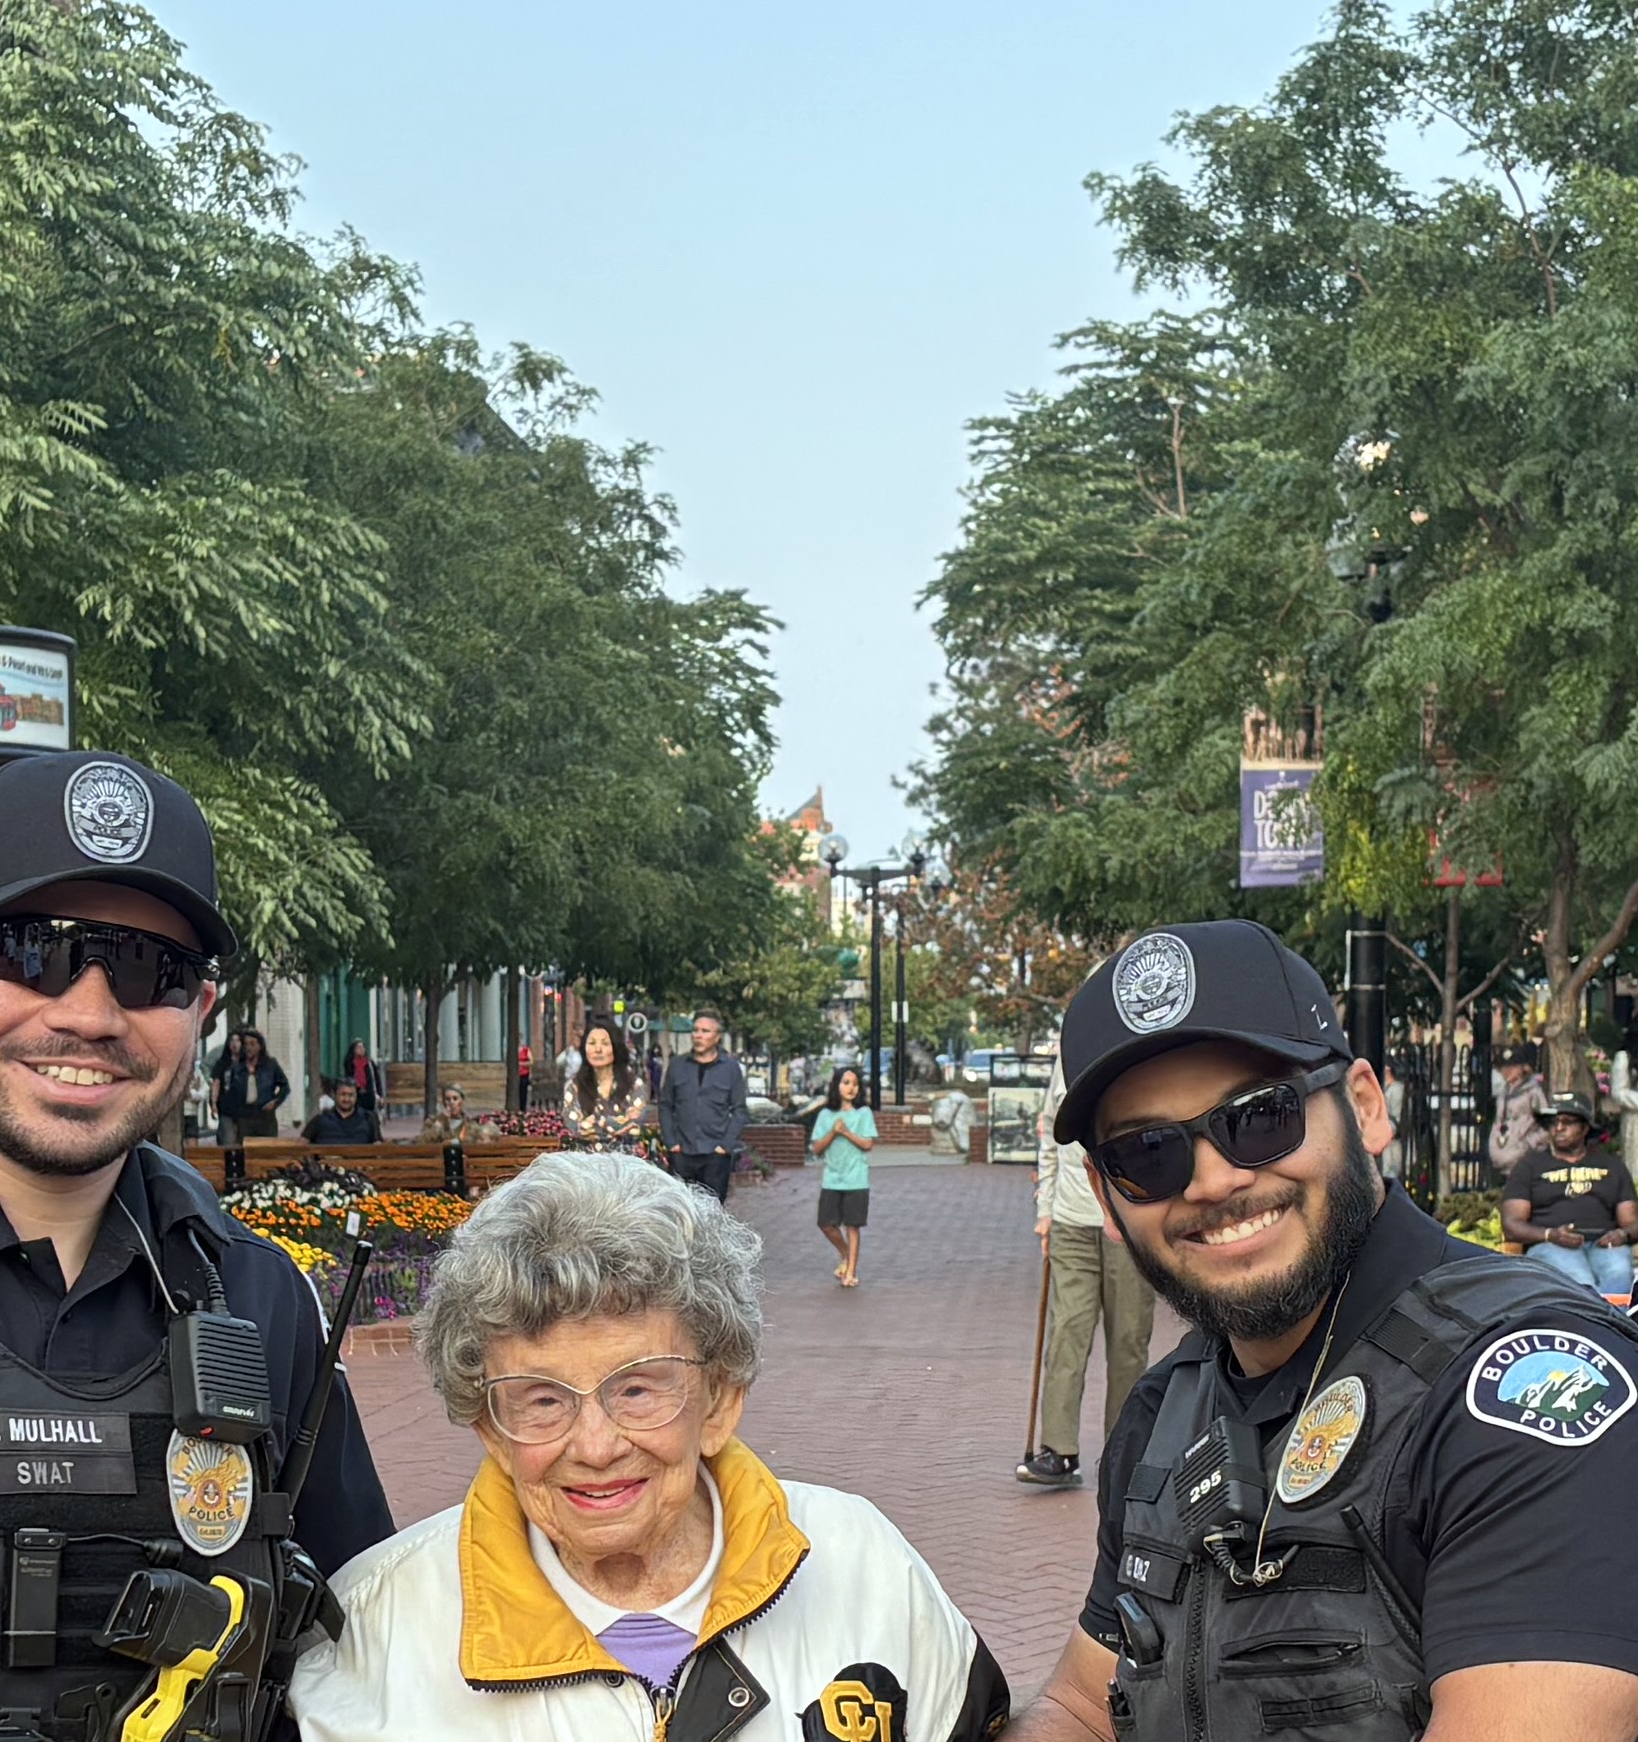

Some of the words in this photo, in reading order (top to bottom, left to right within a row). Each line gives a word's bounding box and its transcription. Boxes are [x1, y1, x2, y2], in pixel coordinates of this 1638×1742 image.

[1481, 1335, 1608, 1382] BOULDER
[8, 1418, 102, 1443] MULHALL
[1519, 1400, 1613, 1438] POLICE
[16, 1461, 75, 1485] SWAT
[1189, 1469, 1222, 1504] 295
[189, 1506, 236, 1522] POLICE
